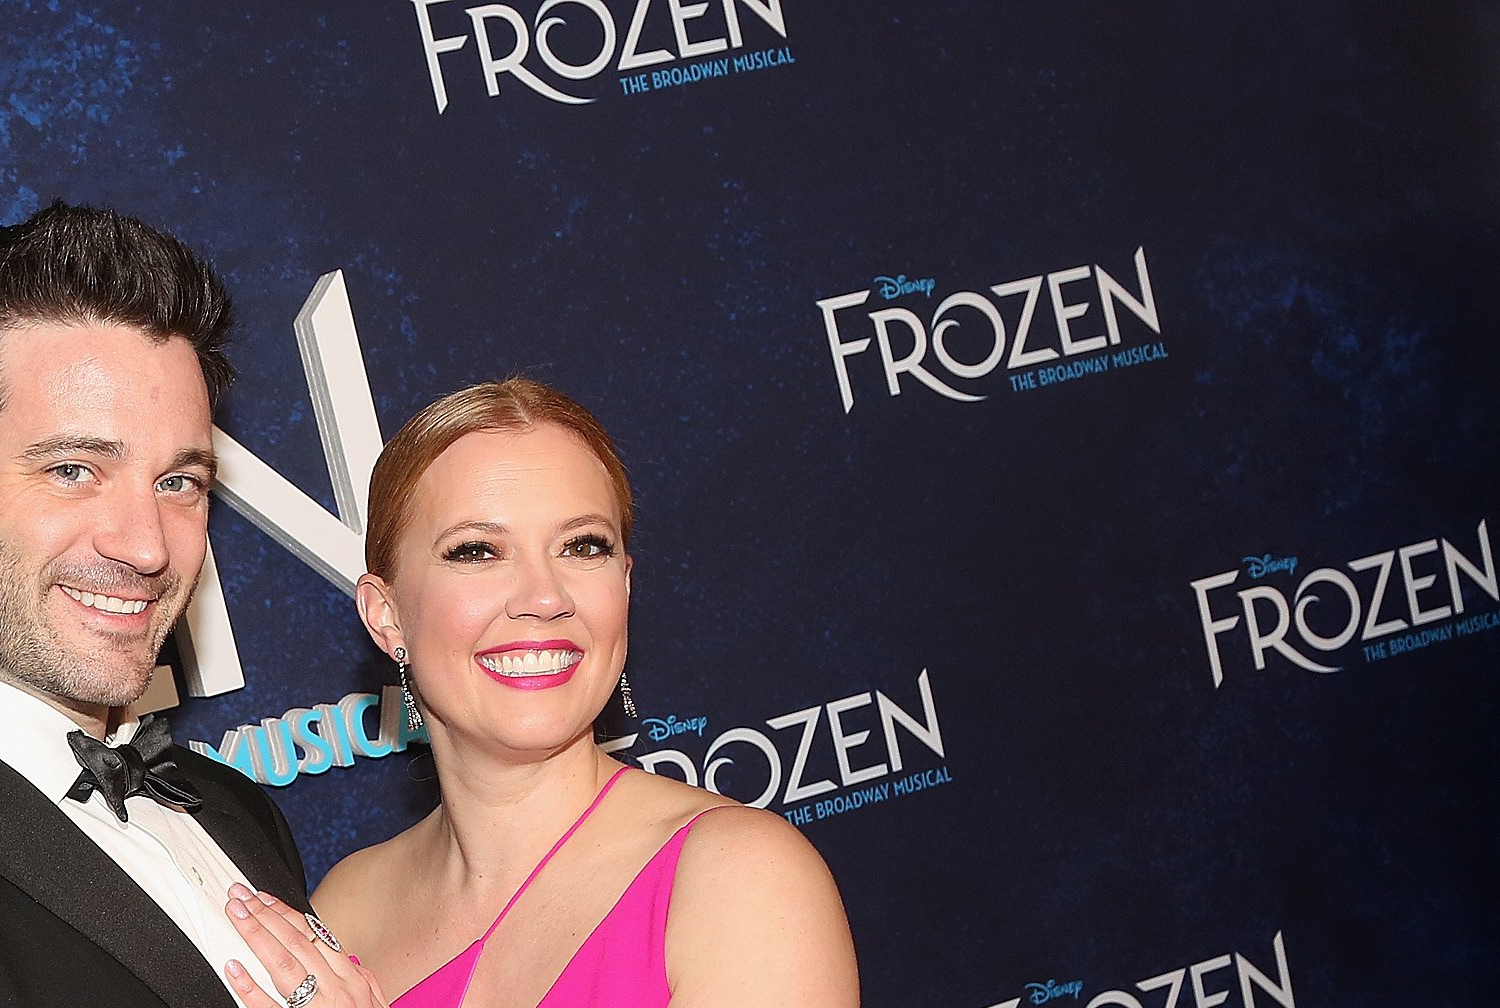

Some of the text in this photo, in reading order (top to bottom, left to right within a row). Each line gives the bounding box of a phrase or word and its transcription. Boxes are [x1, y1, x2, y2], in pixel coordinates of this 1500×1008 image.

[619, 47, 795, 95] THE BROADWAY MUSICAL
[815, 245, 1161, 414] FROZEN
[1009, 343, 1169, 393] THE BROADWAY MUSICAL
[1190, 518, 1500, 689] FROZEN
[1362, 643, 1387, 663] THE
[1389, 625, 1453, 656] BROADWAY
[785, 766, 953, 826] THE BROADWAY MUSICAL
